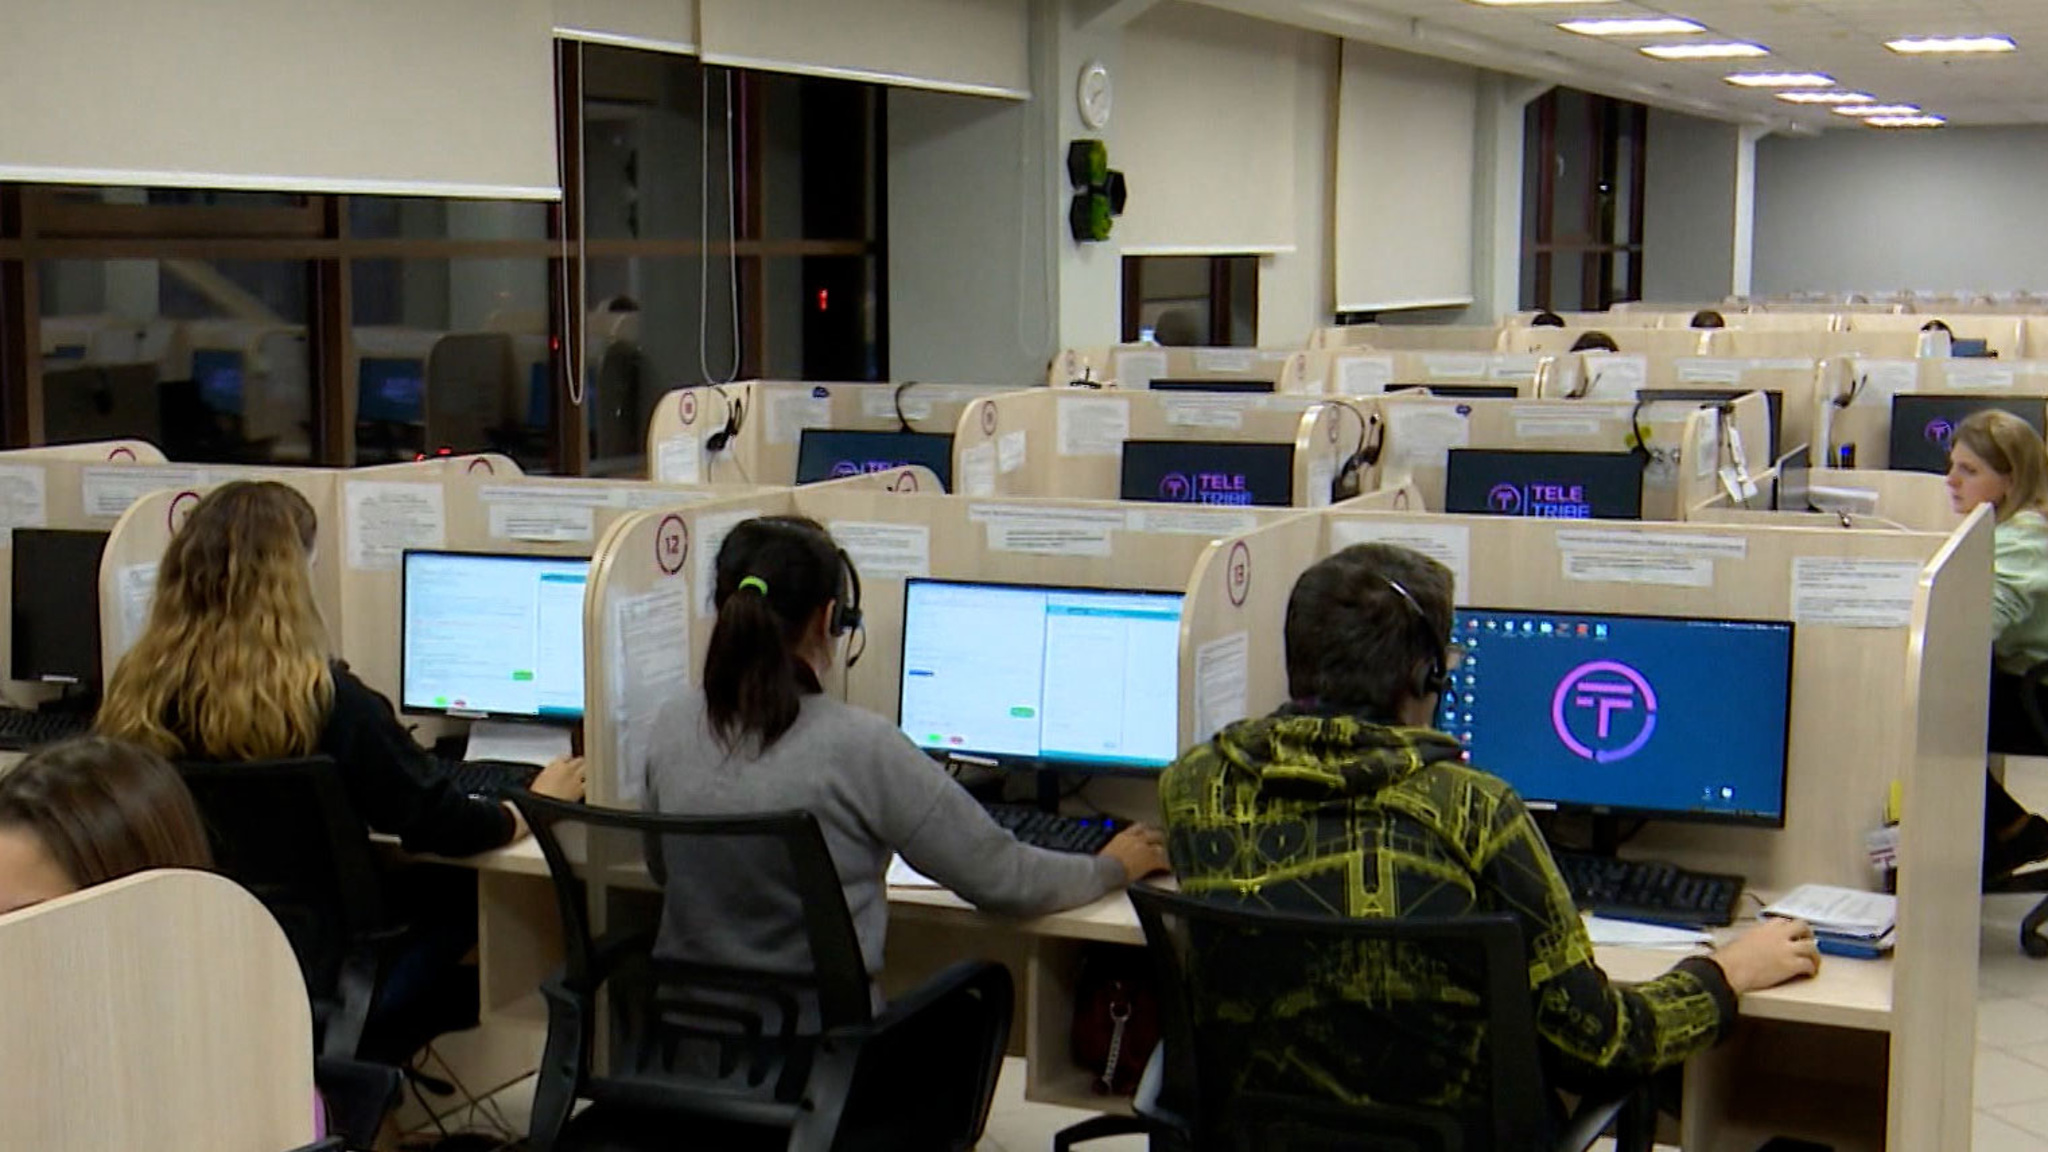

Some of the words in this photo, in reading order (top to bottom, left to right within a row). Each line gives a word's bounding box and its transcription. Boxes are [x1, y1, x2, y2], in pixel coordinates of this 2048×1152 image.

[1199, 475, 1246, 490] TELE
[1531, 486, 1583, 502] TELE
[1532, 503, 1591, 519] TRIBE
[665, 535, 679, 554] 12
